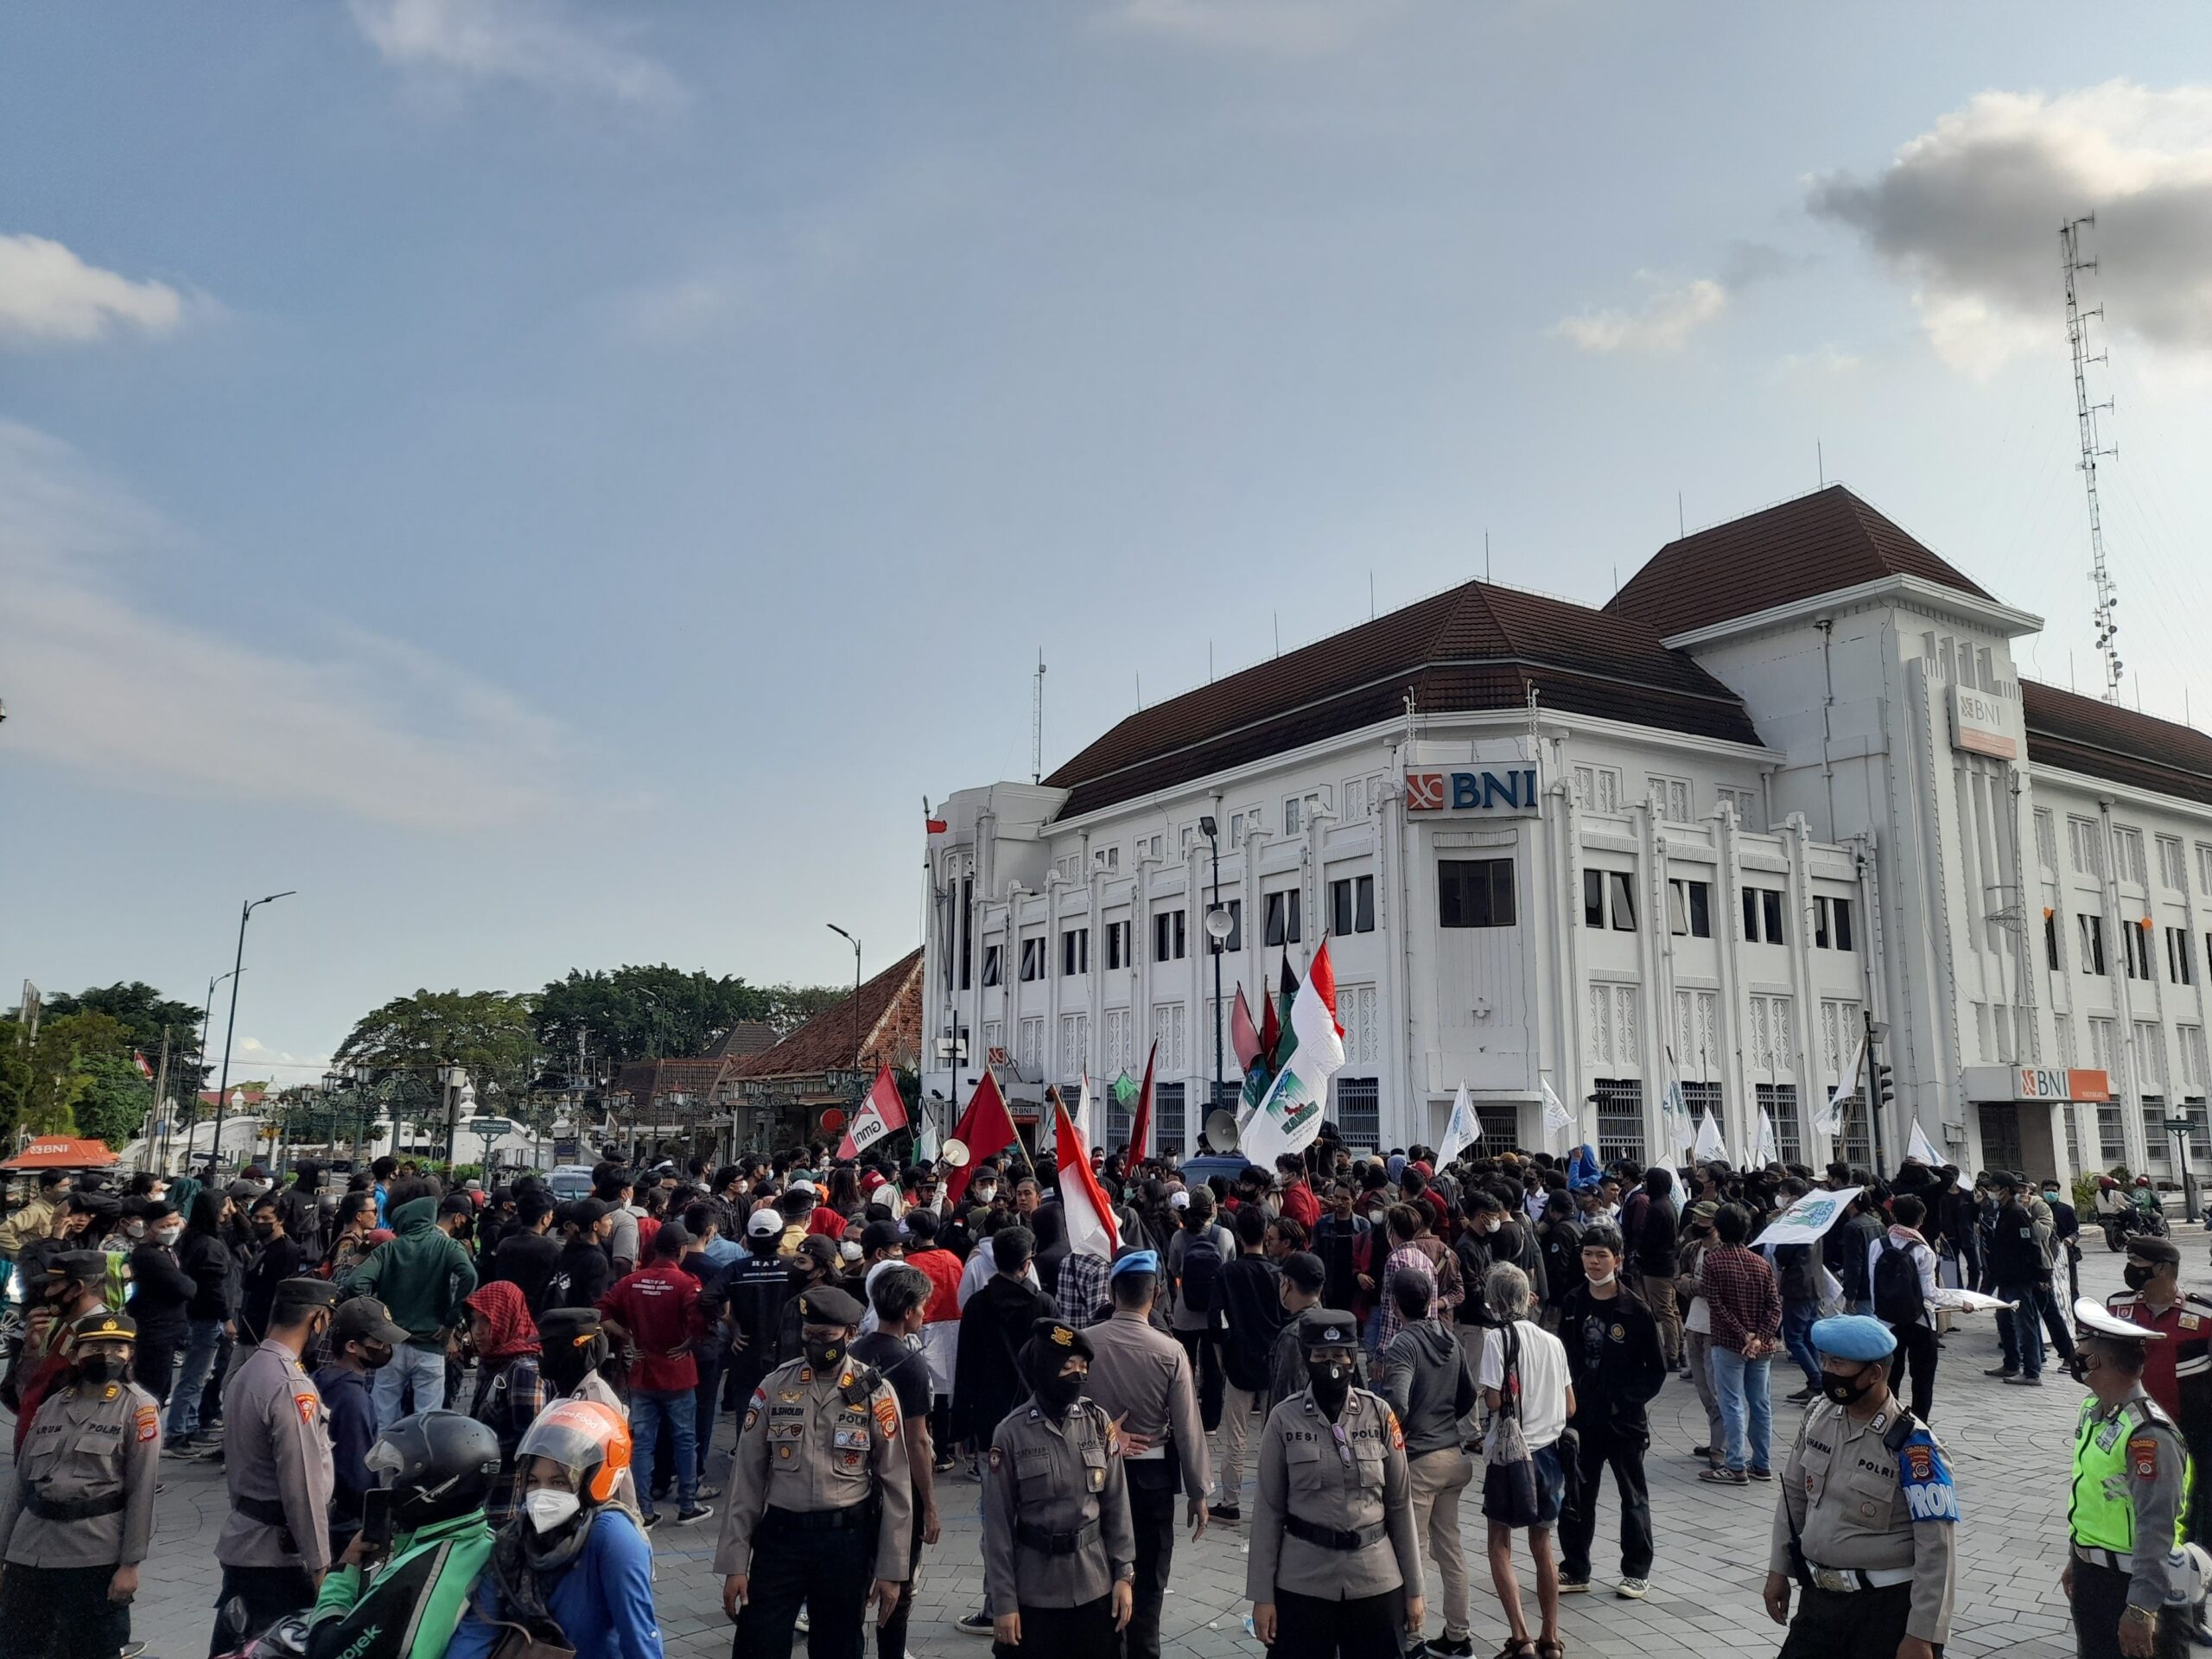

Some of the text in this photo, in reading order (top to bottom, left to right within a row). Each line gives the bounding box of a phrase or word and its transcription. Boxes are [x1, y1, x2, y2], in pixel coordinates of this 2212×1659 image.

[1975, 699, 2000, 726] BNI
[1451, 770, 1536, 809] BNI
[2037, 1071, 2068, 1097] BNI
[43, 1144, 69, 1154] BNI
[1286, 1432, 1318, 1442] DESI
[1858, 1458, 1894, 1479] POLRI
